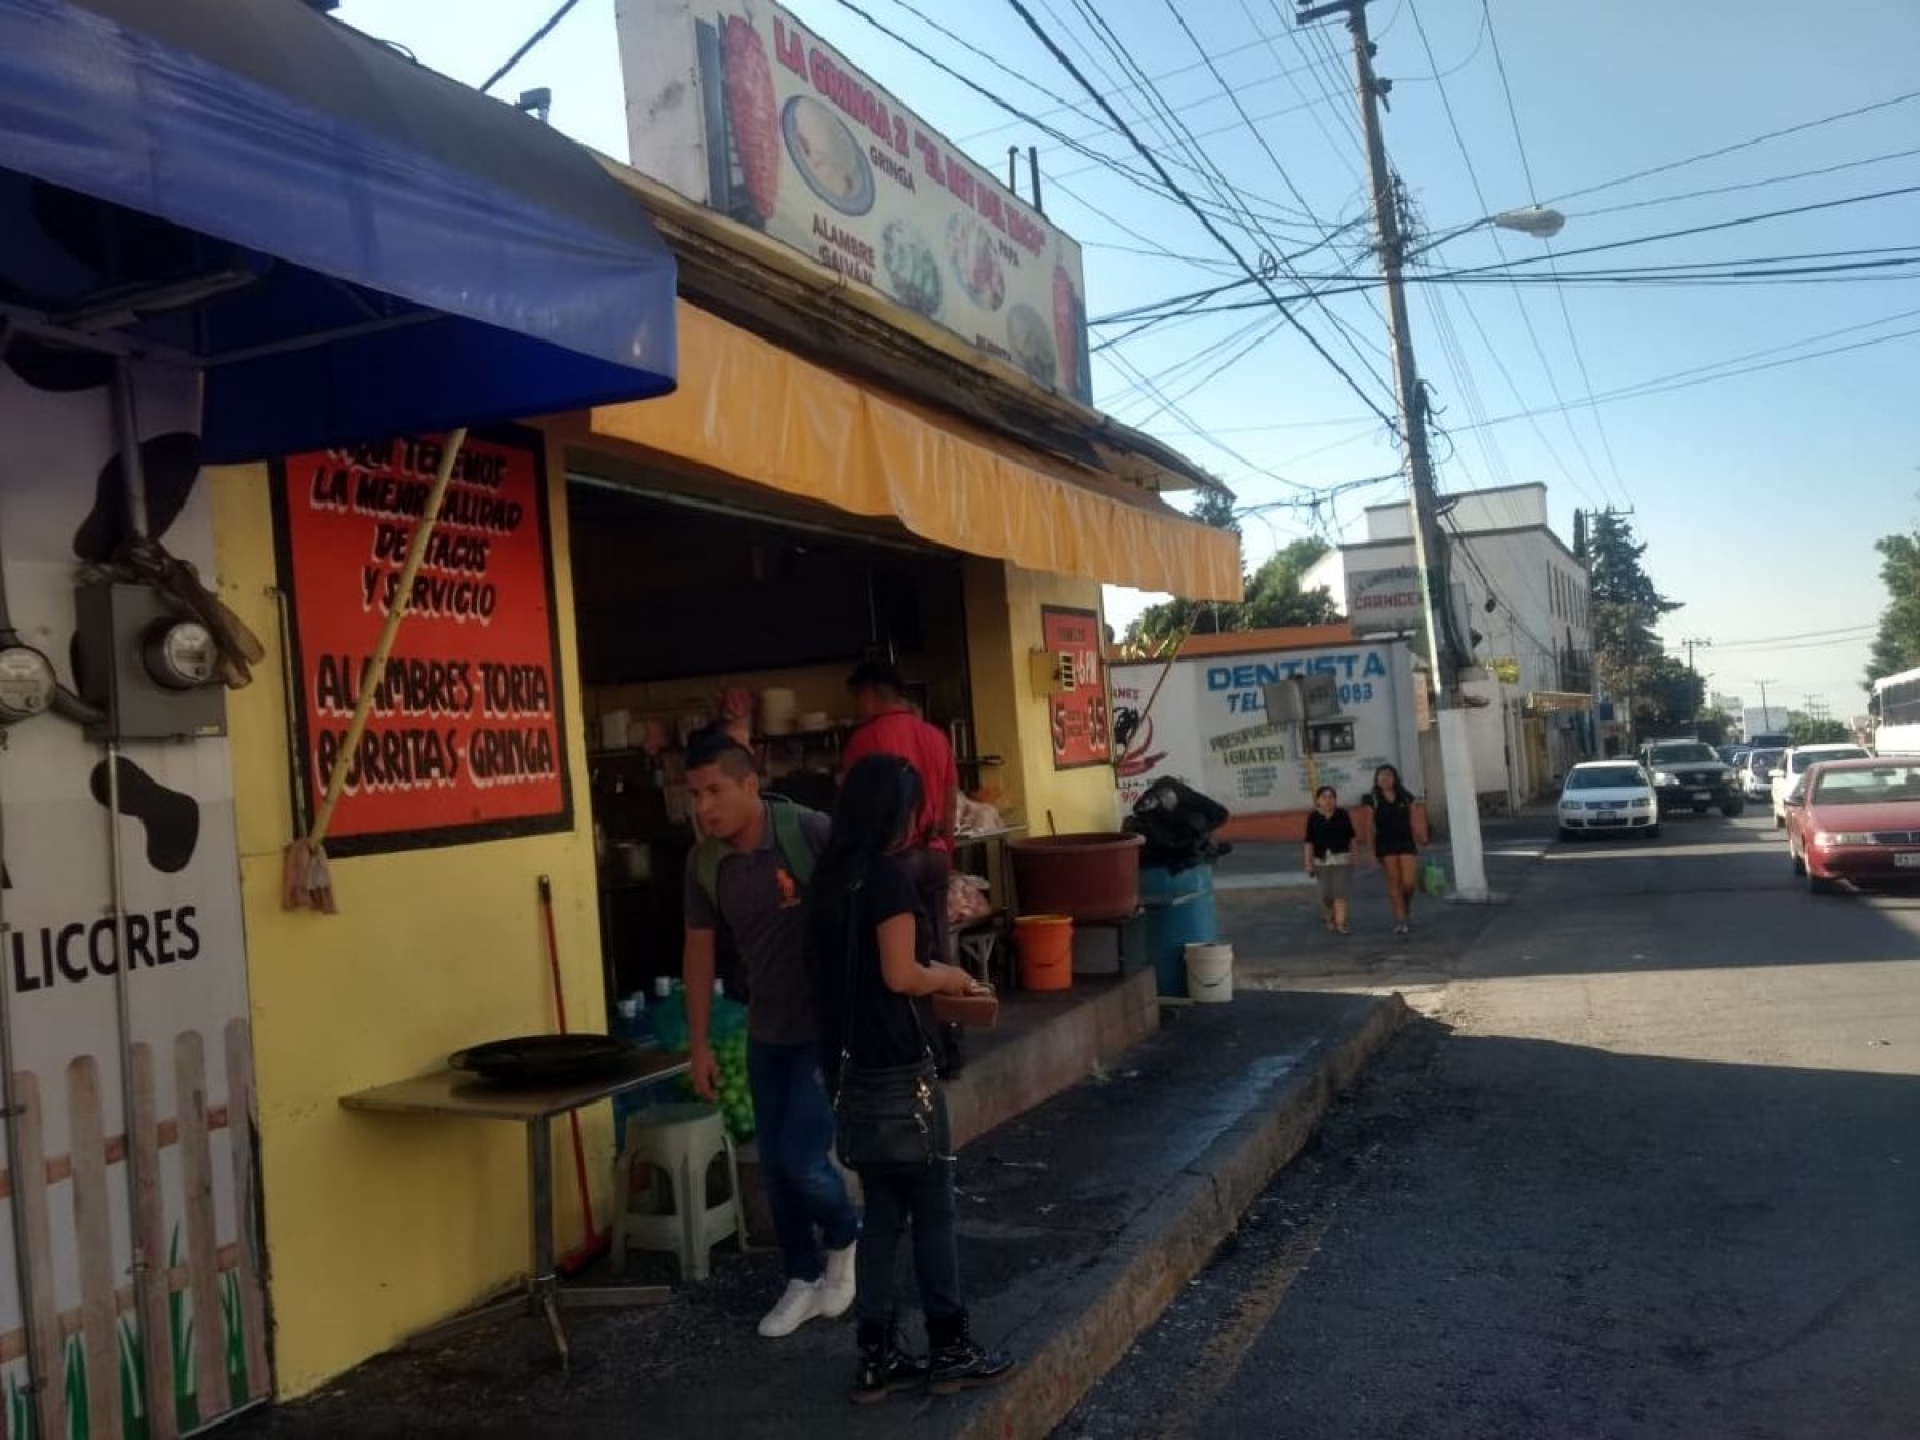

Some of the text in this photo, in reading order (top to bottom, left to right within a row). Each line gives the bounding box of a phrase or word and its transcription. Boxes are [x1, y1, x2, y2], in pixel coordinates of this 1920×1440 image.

[773, 15, 808, 83] LA
[808, 47, 894, 149] GRINGA
[869, 145, 916, 195] GRINGA
[812, 213, 876, 270] ALAMBRE
[401, 440, 506, 493] TEEMOS
[310, 463, 349, 513] LA
[434, 490, 524, 536] ALIDAD
[372, 522, 492, 577] DE TACOS
[362, 564, 498, 627] Y SRVICIO
[1206, 652, 1387, 691] DENTISTA
[467, 726, 556, 788] GRINGA
[12, 904, 200, 993] LICORES
